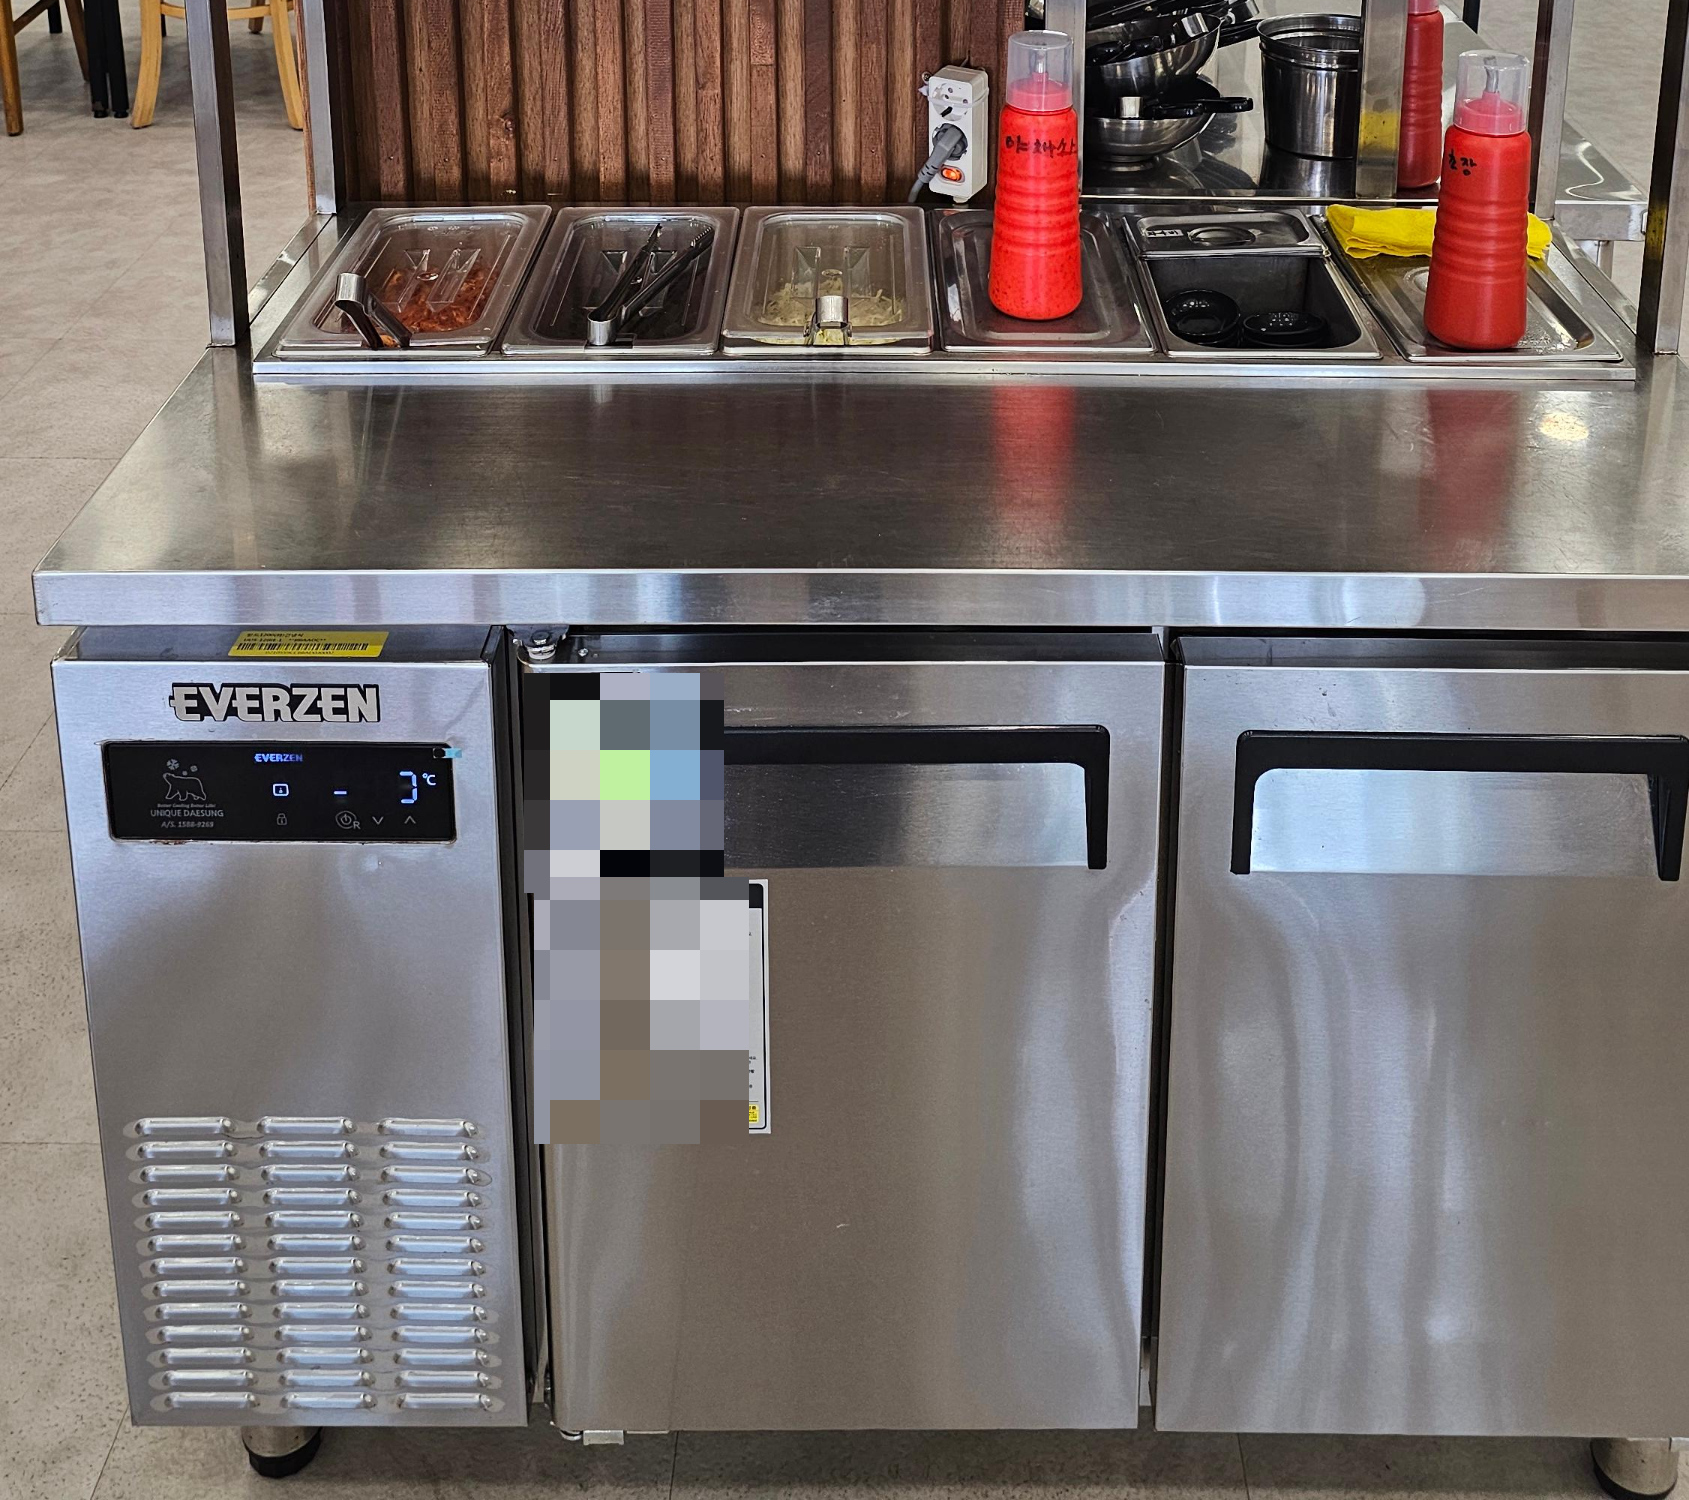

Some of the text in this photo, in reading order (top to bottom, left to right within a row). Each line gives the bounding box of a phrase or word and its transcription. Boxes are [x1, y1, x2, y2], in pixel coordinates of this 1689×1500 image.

[169, 683, 380, 722] EVERZEN
[254, 753, 303, 763] EVERZEN
[150, 809, 224, 818] UNIQUE DAESUNG
